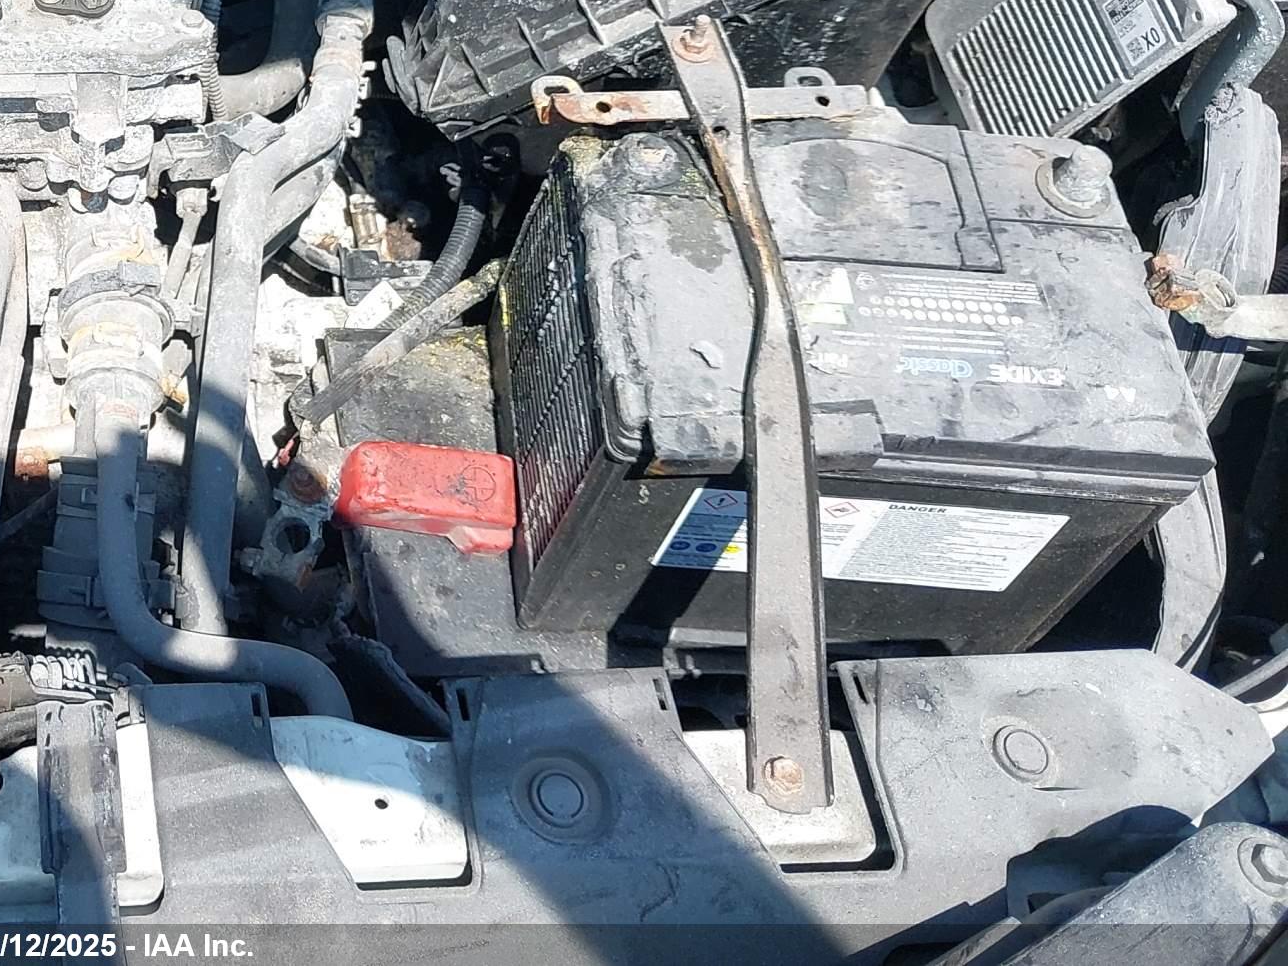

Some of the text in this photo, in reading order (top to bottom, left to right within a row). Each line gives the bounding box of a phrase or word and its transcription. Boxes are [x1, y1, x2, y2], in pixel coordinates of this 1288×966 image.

[896, 356, 1064, 386] EXIDE Classic
[888, 504, 947, 514] DANGER
